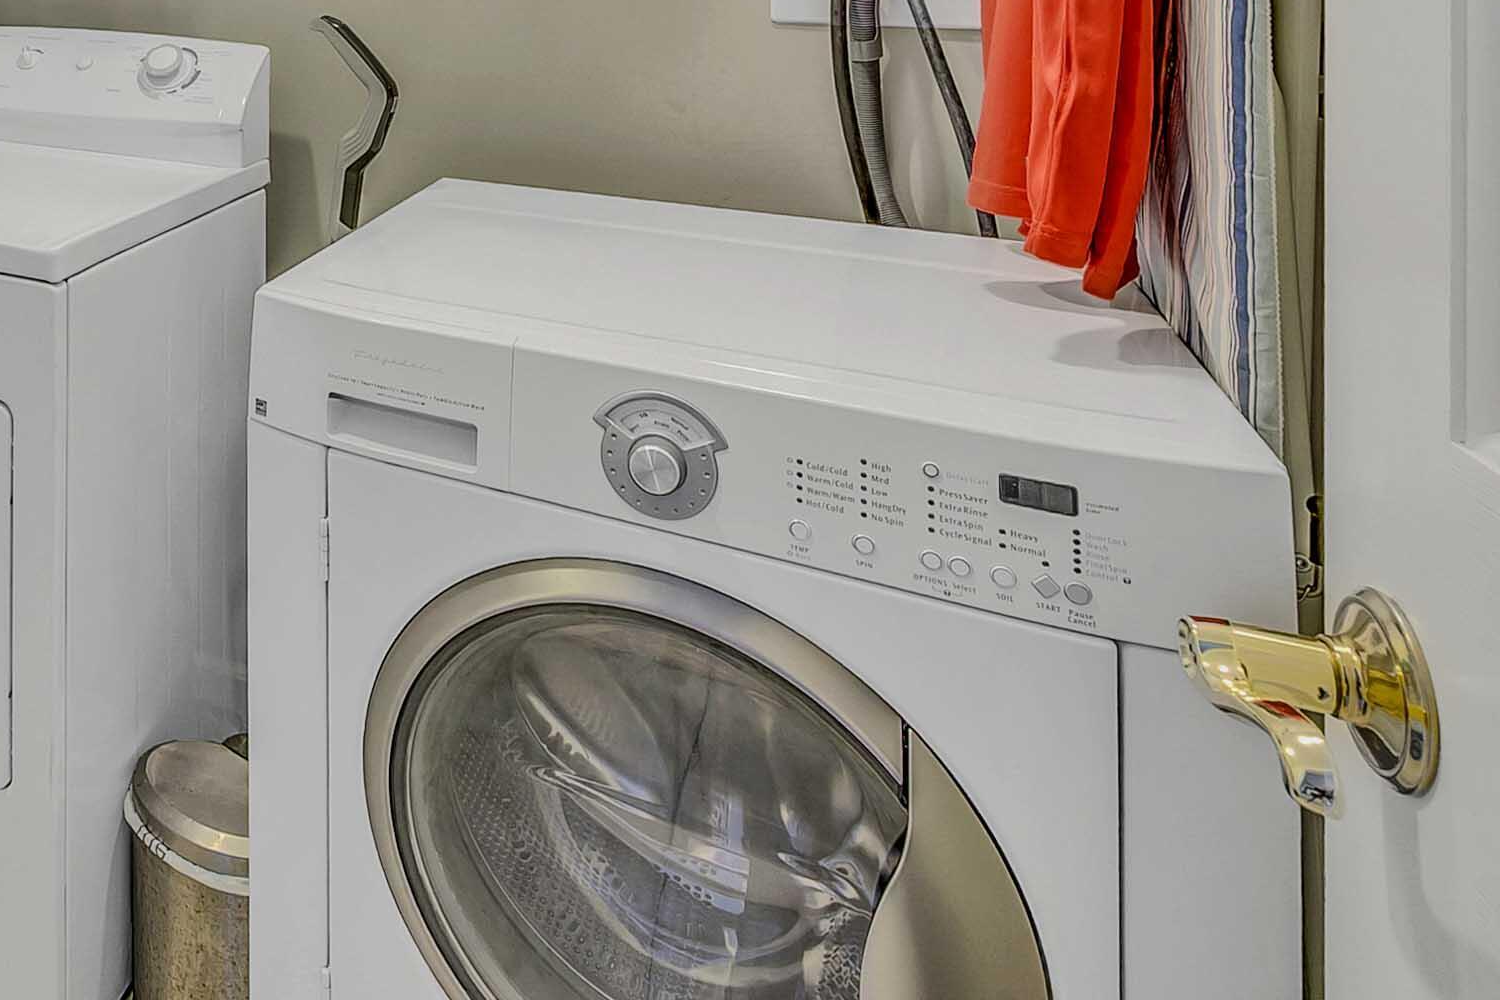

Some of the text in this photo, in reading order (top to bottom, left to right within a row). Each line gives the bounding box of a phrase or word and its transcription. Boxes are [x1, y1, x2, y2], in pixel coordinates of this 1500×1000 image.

[805, 462, 848, 476] Cold/Cold
[871, 463, 892, 473] High
[806, 474, 854, 490] Warm/Cold
[871, 475, 890, 485] Med
[806, 487, 856, 503] Warm/Warm
[871, 488, 888, 497] Low
[805, 499, 845, 514] Hot/Cold
[1010, 529, 1039, 543] Heavy
[1010, 543, 1046, 558] Normal
[856, 559, 874, 569] SPIN
[913, 573, 977, 594] OPTIONS Select
[996, 593, 1014, 603] SOIL
[1036, 602, 1061, 613] START
[1068, 609, 1094, 620] Pause
[1067, 617, 1097, 629] Cancel
